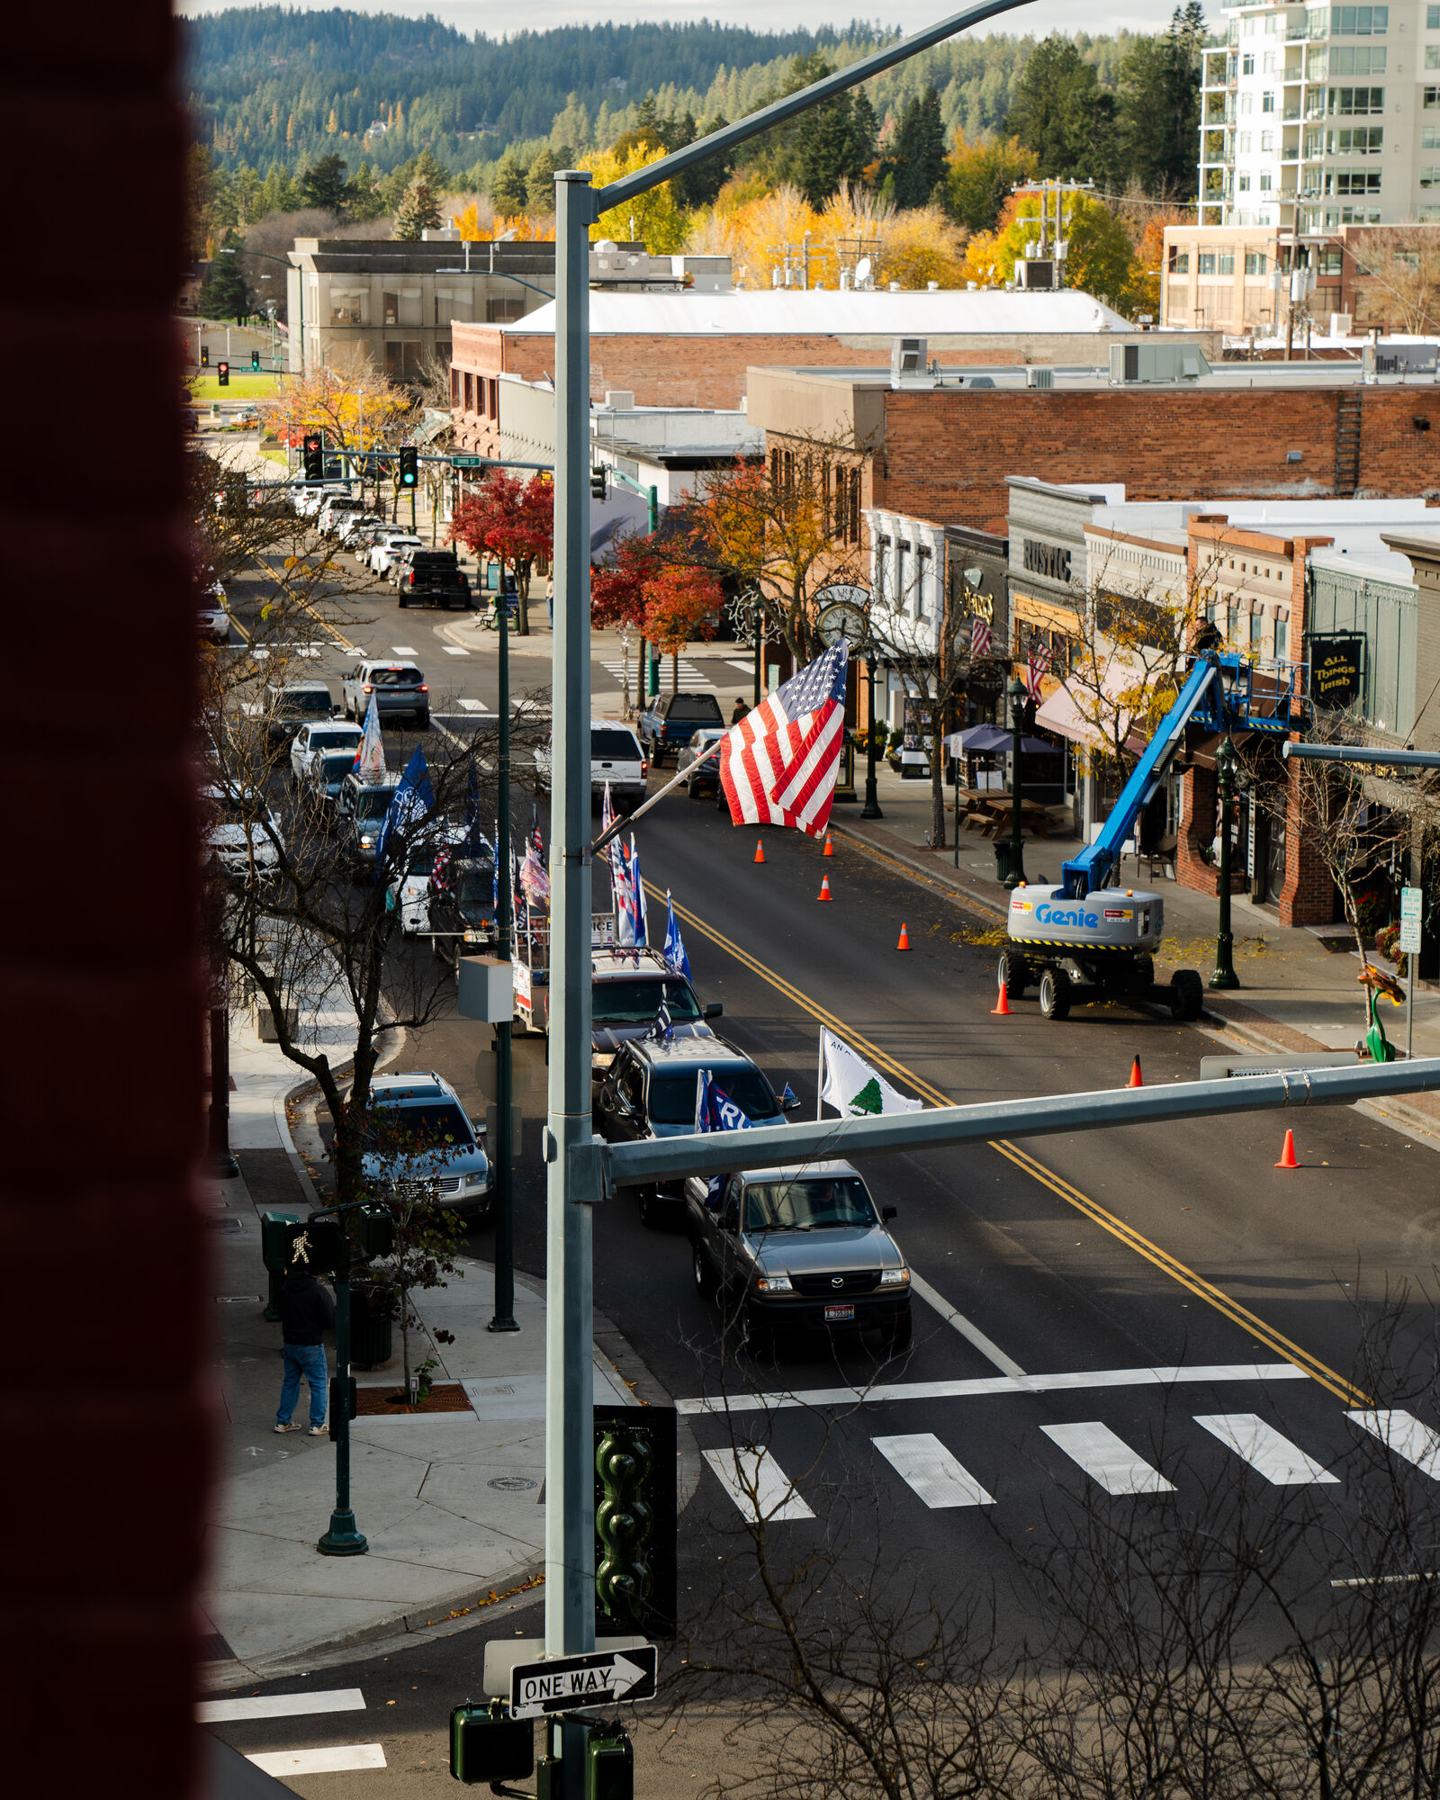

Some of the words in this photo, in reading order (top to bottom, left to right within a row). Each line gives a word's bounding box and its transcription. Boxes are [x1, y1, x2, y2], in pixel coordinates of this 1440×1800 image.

[1023, 538, 1071, 583] RUSTIC
[1035, 903, 1099, 928] Genie
[525, 1676, 563, 1700] ONE
[570, 1668, 612, 1693] WAY
